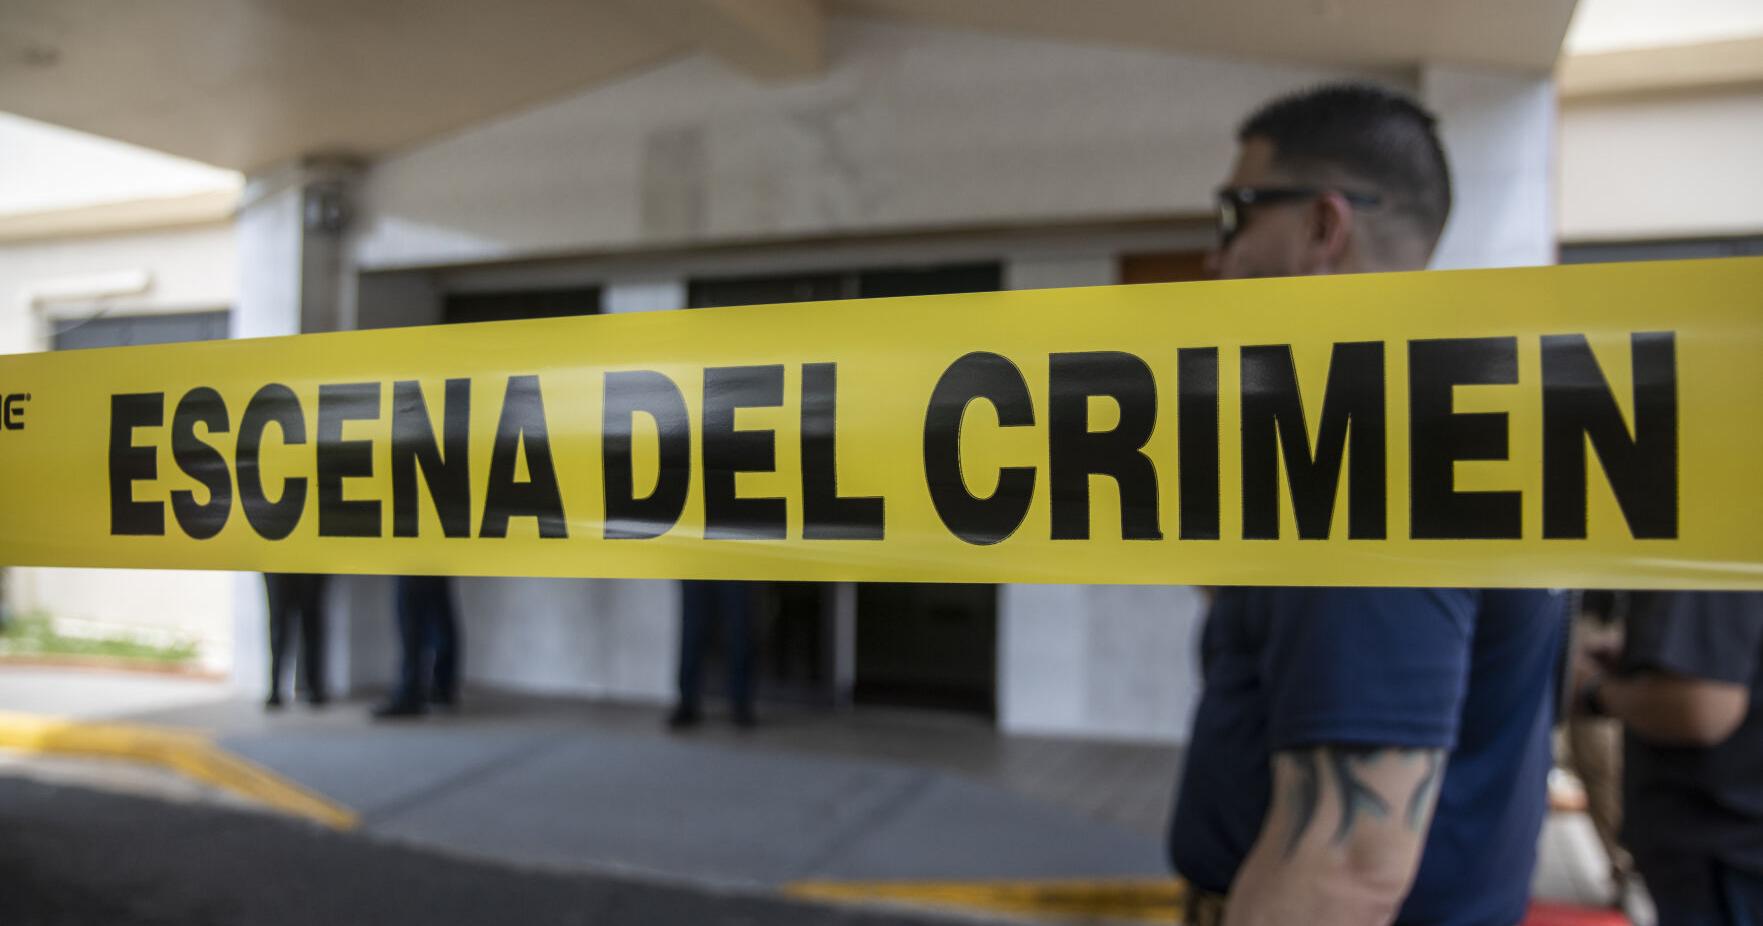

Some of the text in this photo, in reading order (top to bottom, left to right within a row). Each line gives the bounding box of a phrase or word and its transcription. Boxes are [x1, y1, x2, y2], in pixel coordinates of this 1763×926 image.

[109, 331, 1679, 546] ESCENA DEL CRIMEN
